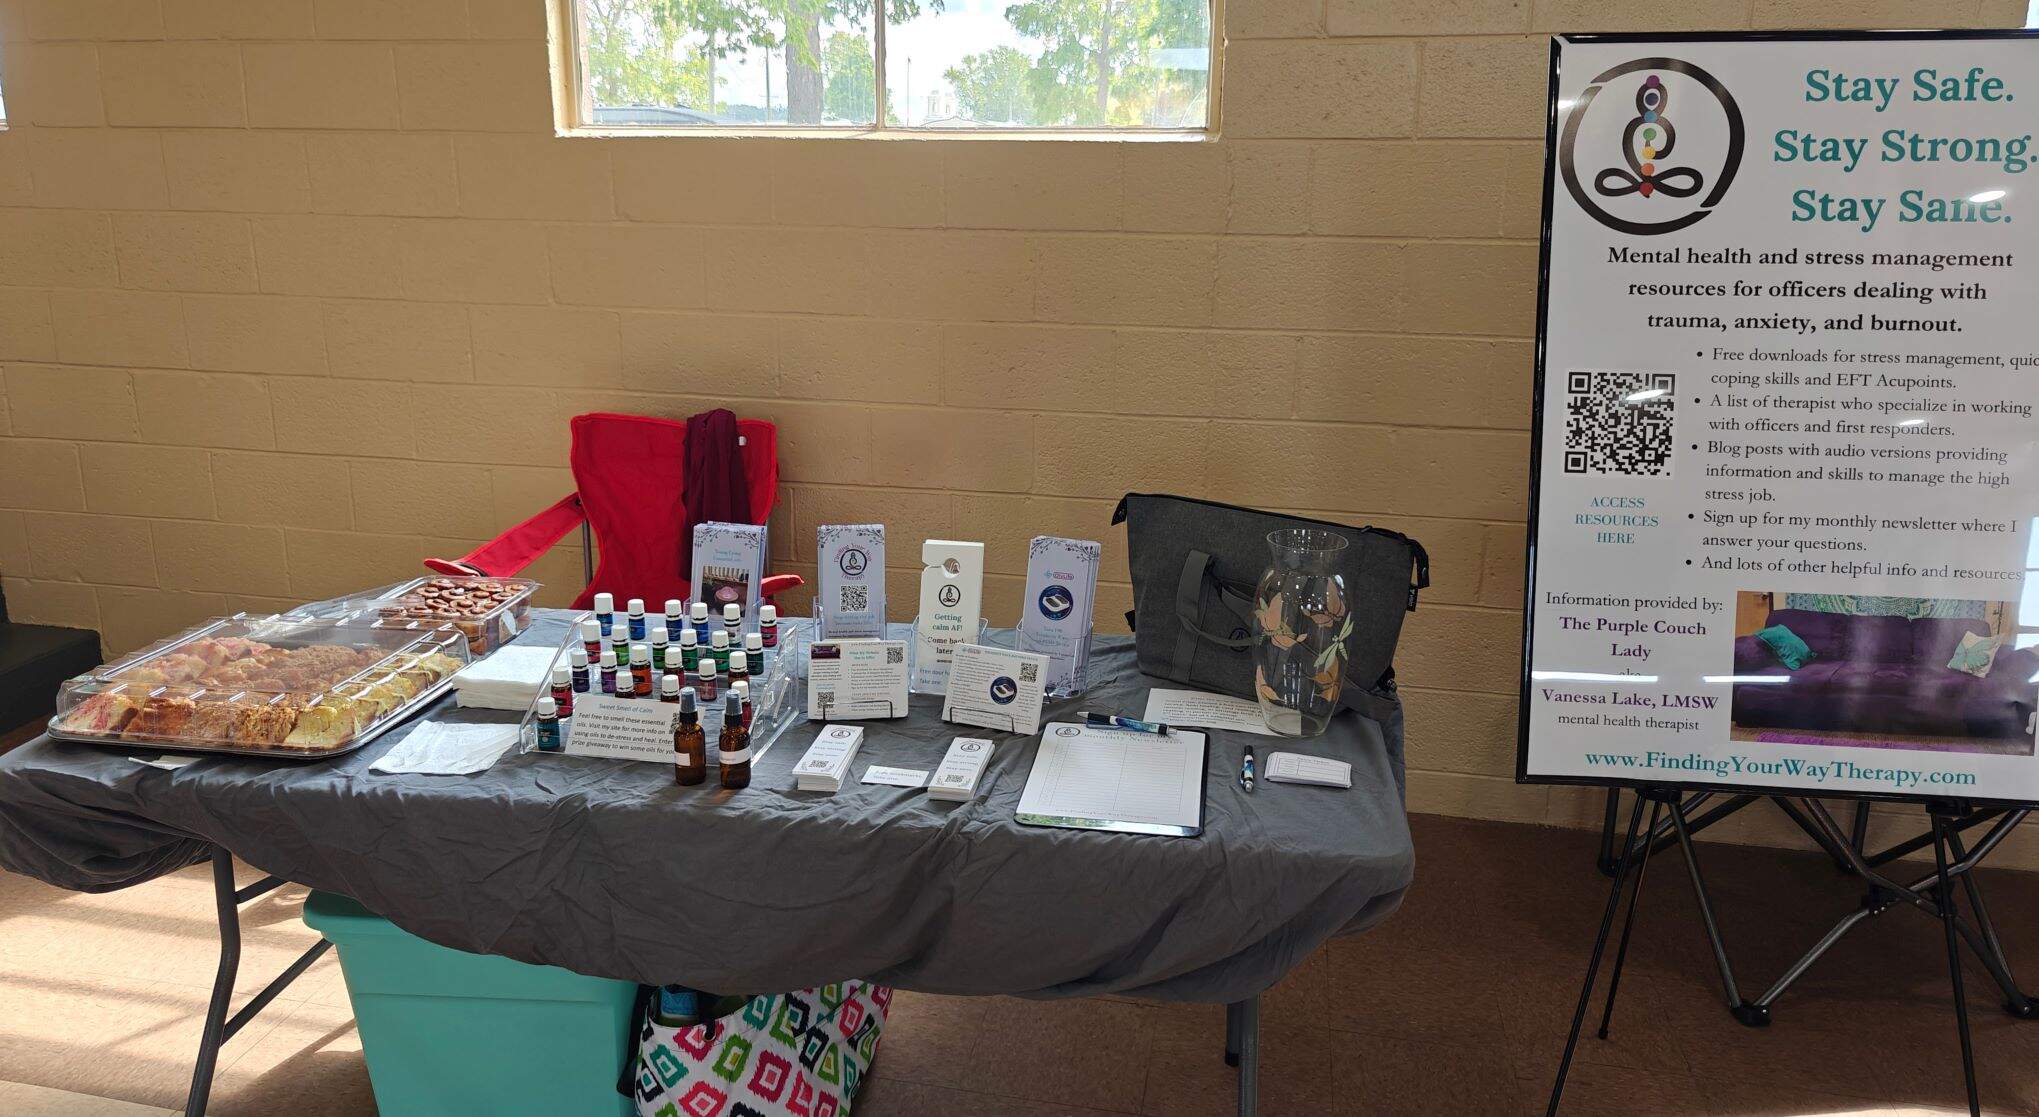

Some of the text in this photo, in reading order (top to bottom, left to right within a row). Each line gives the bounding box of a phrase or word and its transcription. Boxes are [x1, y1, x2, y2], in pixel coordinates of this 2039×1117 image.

[1806, 68, 2013, 112] Stay Safe.
[1774, 130, 2039, 173] Stay Strong.
[1792, 190, 2012, 232] Stay Sane.
[1607, 247, 2013, 270] Mental health and stress management
[1628, 279, 1987, 304] resources for officers dealing with
[1647, 313, 1962, 335] trauma, anxiety, and burnout.
[1713, 348, 1744, 361] Free
[1749, 348, 1828, 362] downloads
[1834, 350, 1856, 363] for
[1860, 354, 1901, 364] stress
[1906, 354, 2005, 369] management,
[1711, 372, 1956, 391] coping skills and EFT Acupoints.
[1710, 394, 2032, 418] A list of therapist who specialize in working
[1709, 418, 1954, 438] with officers and first responders.
[1708, 441, 2008, 465] Blog posts with audio versions providing
[1706, 463, 2010, 489] information and skills to manage the high
[1590, 497, 1645, 508] ACCESS
[1705, 488, 1776, 504] stress job.
[1575, 514, 1659, 527] RESOURCES
[1703, 510, 2018, 532] Sign up for my monthly newsletter where I
[1596, 532, 1635, 544] HERE
[1702, 537, 1867, 553] answer your questions.
[1701, 556, 1732, 569] And
[1738, 557, 1763, 571] lots
[1767, 558, 1784, 572] of
[1788, 560, 1826, 574] other
[1831, 561, 1882, 578] helpful
[1887, 562, 1916, 576] info
[1922, 564, 1948, 577] and
[1546, 592, 1724, 614] Information provided by:
[932, 624, 950, 632] calm
[934, 613, 963, 623] Getting
[1559, 616, 1706, 636] The Purple Couch
[927, 636, 947, 644] Come
[1611, 643, 1651, 662] Lady
[1542, 688, 1720, 710] Vanessa Lake, LMSW
[646, 727, 657, 735] info
[1558, 713, 1699, 733] mental health therapist
[586, 741, 612, 749] giveaway
[607, 733, 631, 741] de-stress
[1585, 751, 1976, 787] www.FindingYourWayTherapy.com
